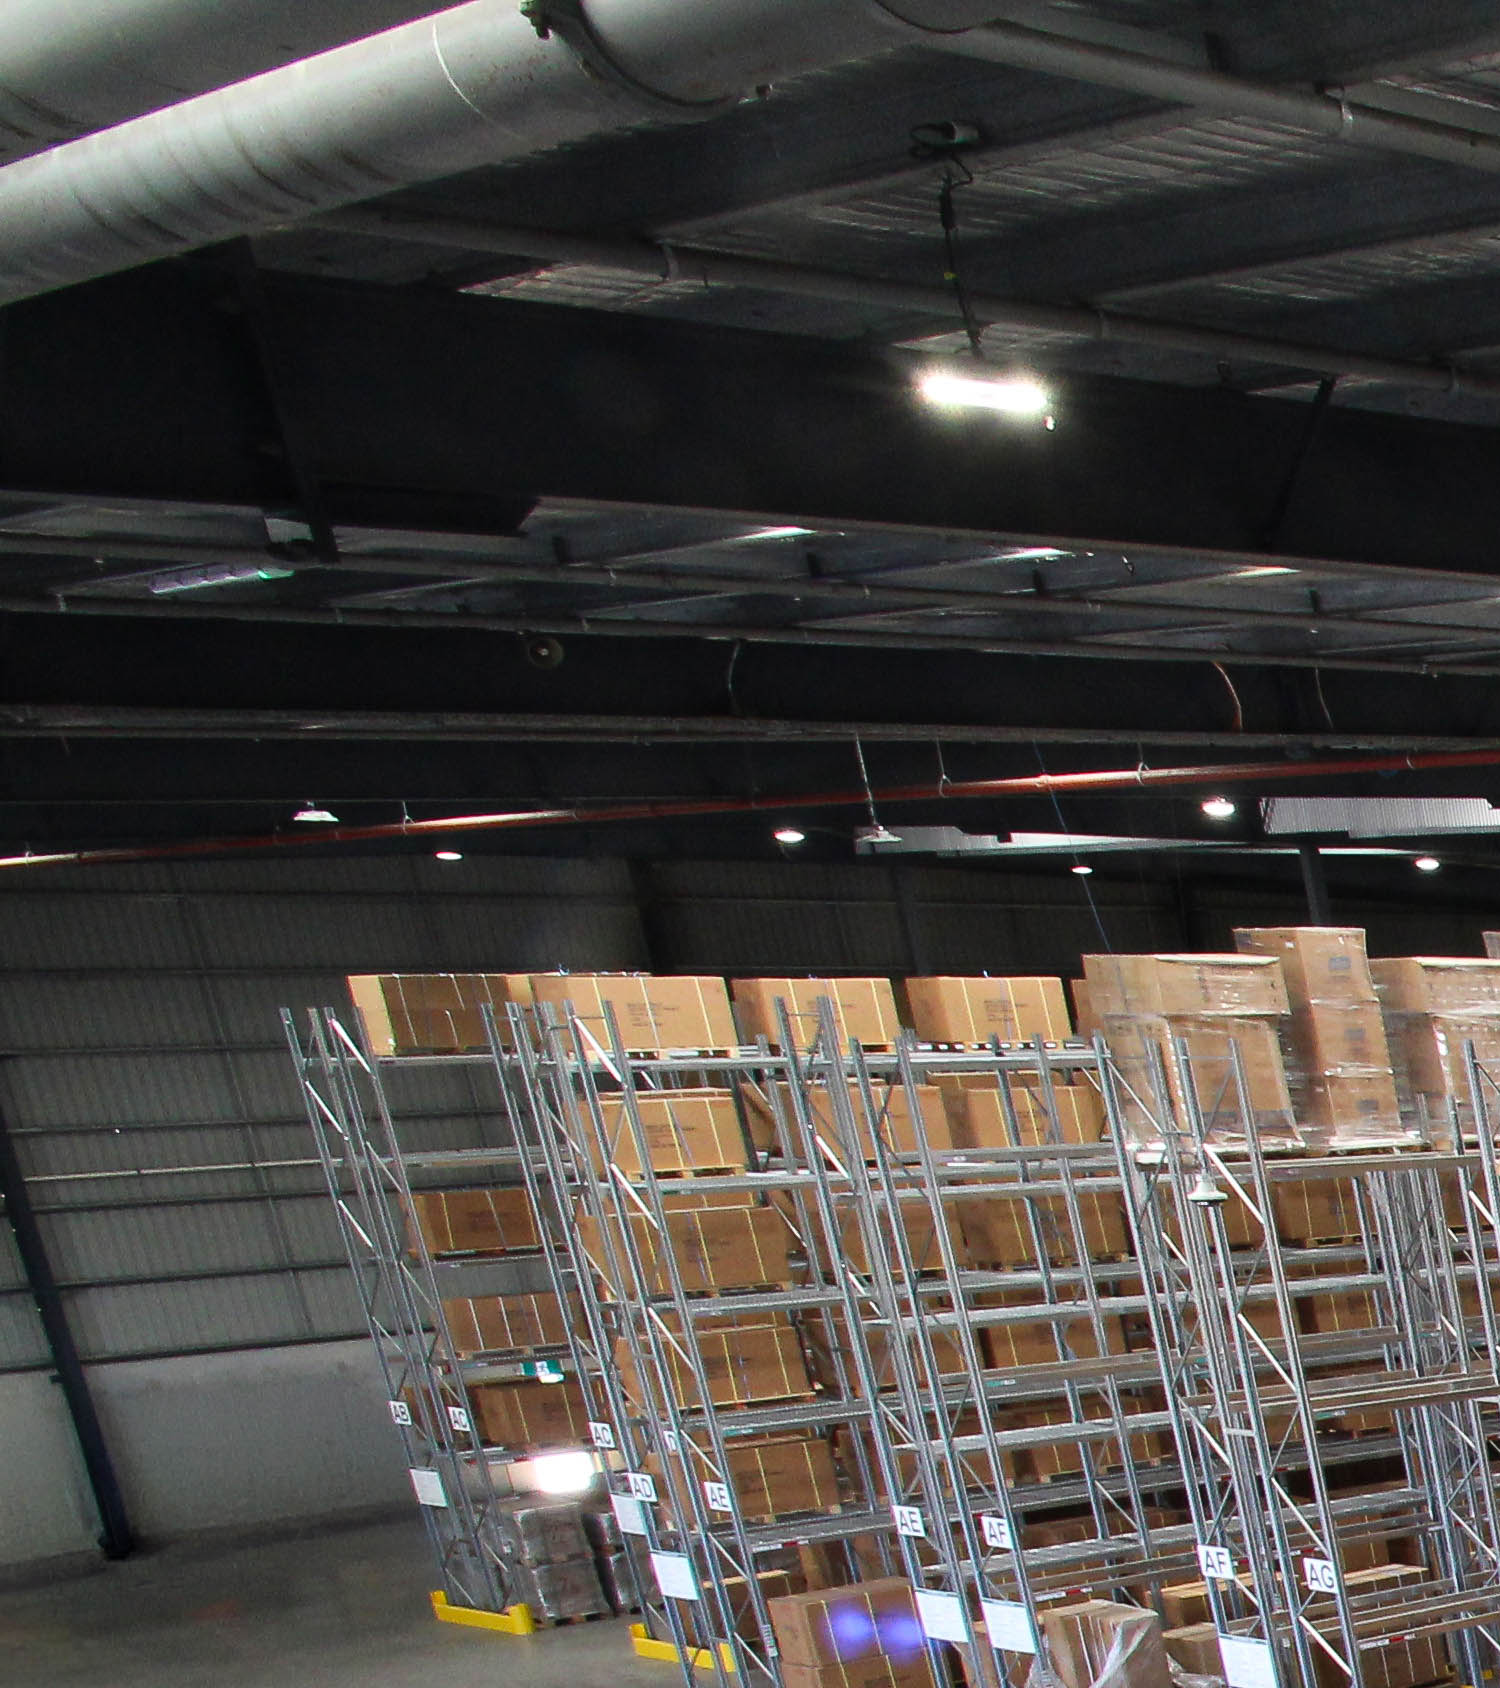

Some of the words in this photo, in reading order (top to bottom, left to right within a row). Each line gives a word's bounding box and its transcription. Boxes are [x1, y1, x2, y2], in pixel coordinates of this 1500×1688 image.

[594, 1426, 611, 1445] AC
[633, 1477, 653, 1498] AD
[710, 1486, 729, 1507] AE
[900, 1510, 921, 1533] AE
[988, 1521, 1006, 1545] AF
[1205, 1550, 1225, 1575] AF
[1309, 1563, 1335, 1588] AG
